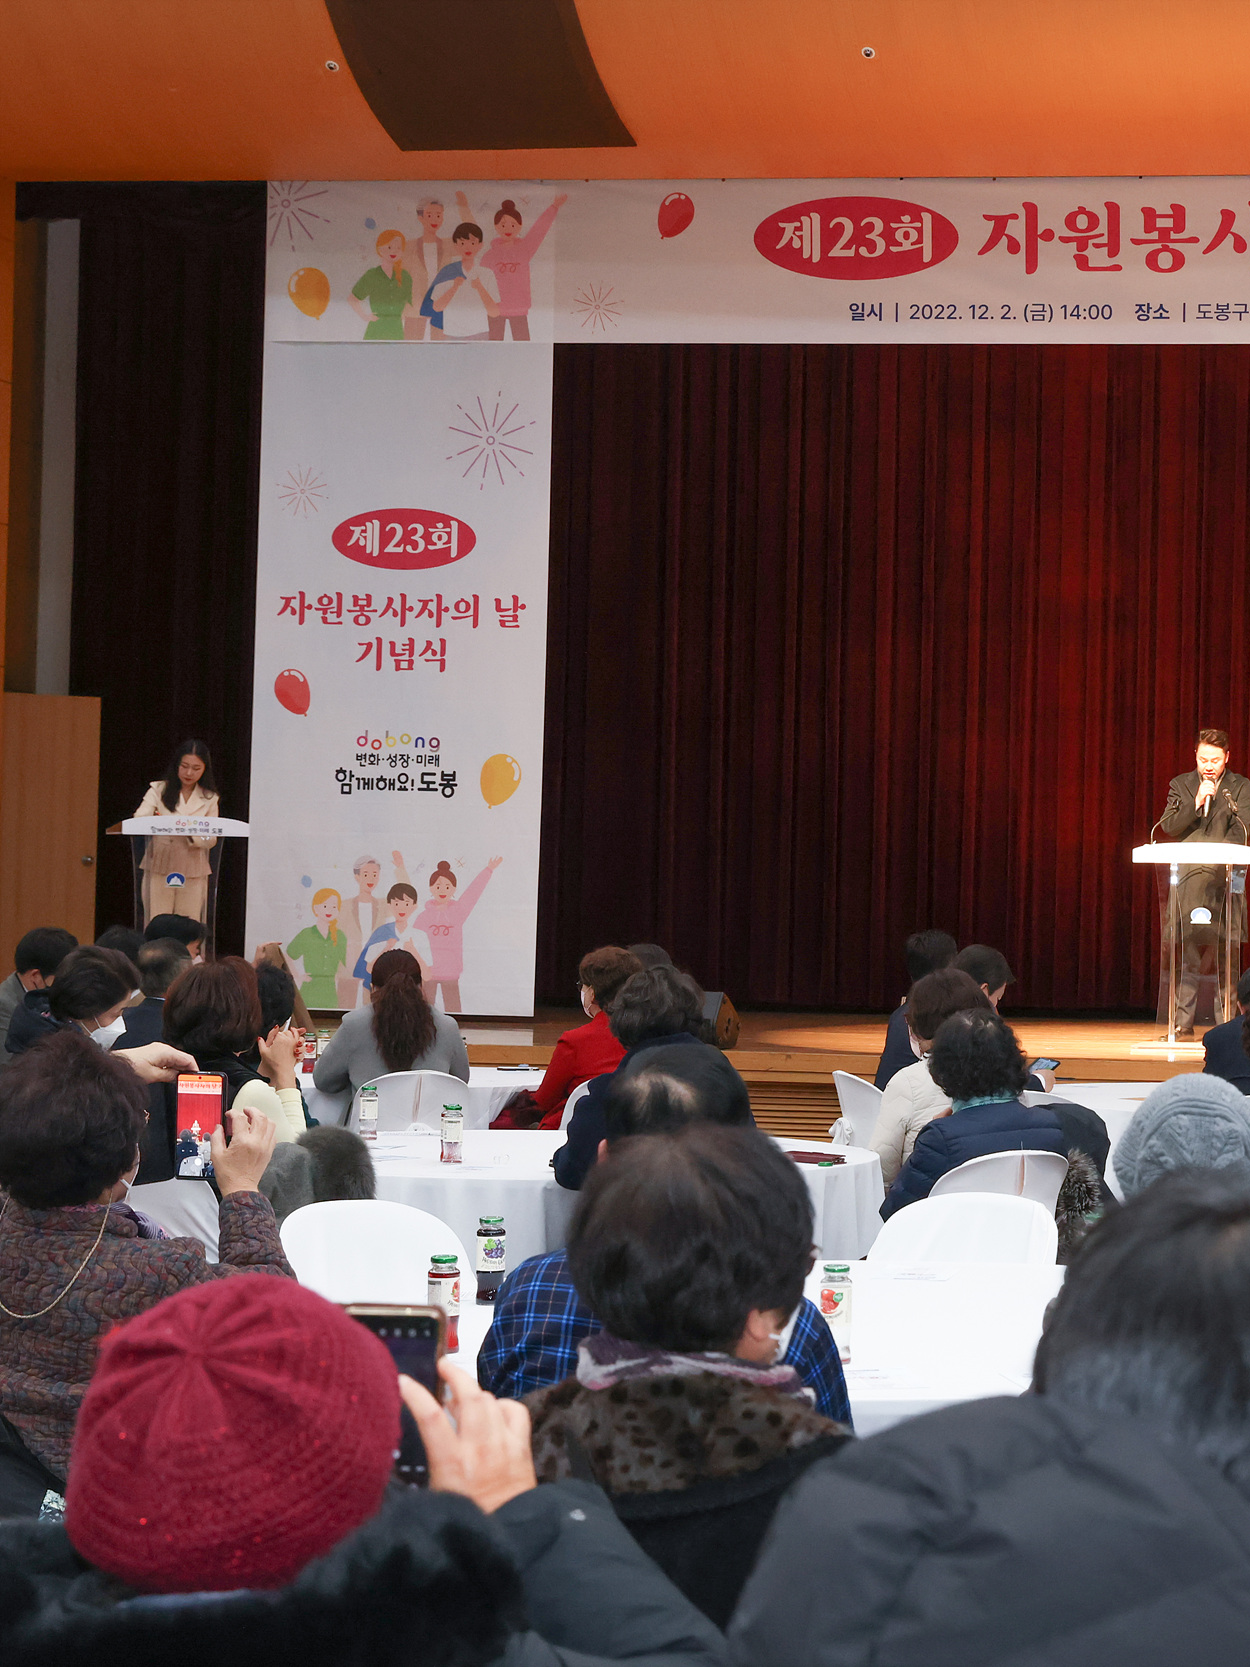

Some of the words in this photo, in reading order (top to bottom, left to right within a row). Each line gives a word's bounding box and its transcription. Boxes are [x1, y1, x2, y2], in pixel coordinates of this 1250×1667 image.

[775, 212, 932, 263] 제23회
[849, 302, 883, 321] 일시
[909, 304, 962, 320] 2022.
[969, 304, 994, 320] 12.
[1001, 304, 1016, 320] 2.
[1023, 303, 1053, 322] (금)
[1060, 304, 1113, 320] 14:00
[1134, 302, 1170, 321] 장소
[347, 520, 458, 558] 제23회
[277, 590, 480, 629] 자원봉사자의
[494, 594, 527, 629] 날
[355, 636, 447, 673] 기념식
[356, 730, 441, 752] dobong
